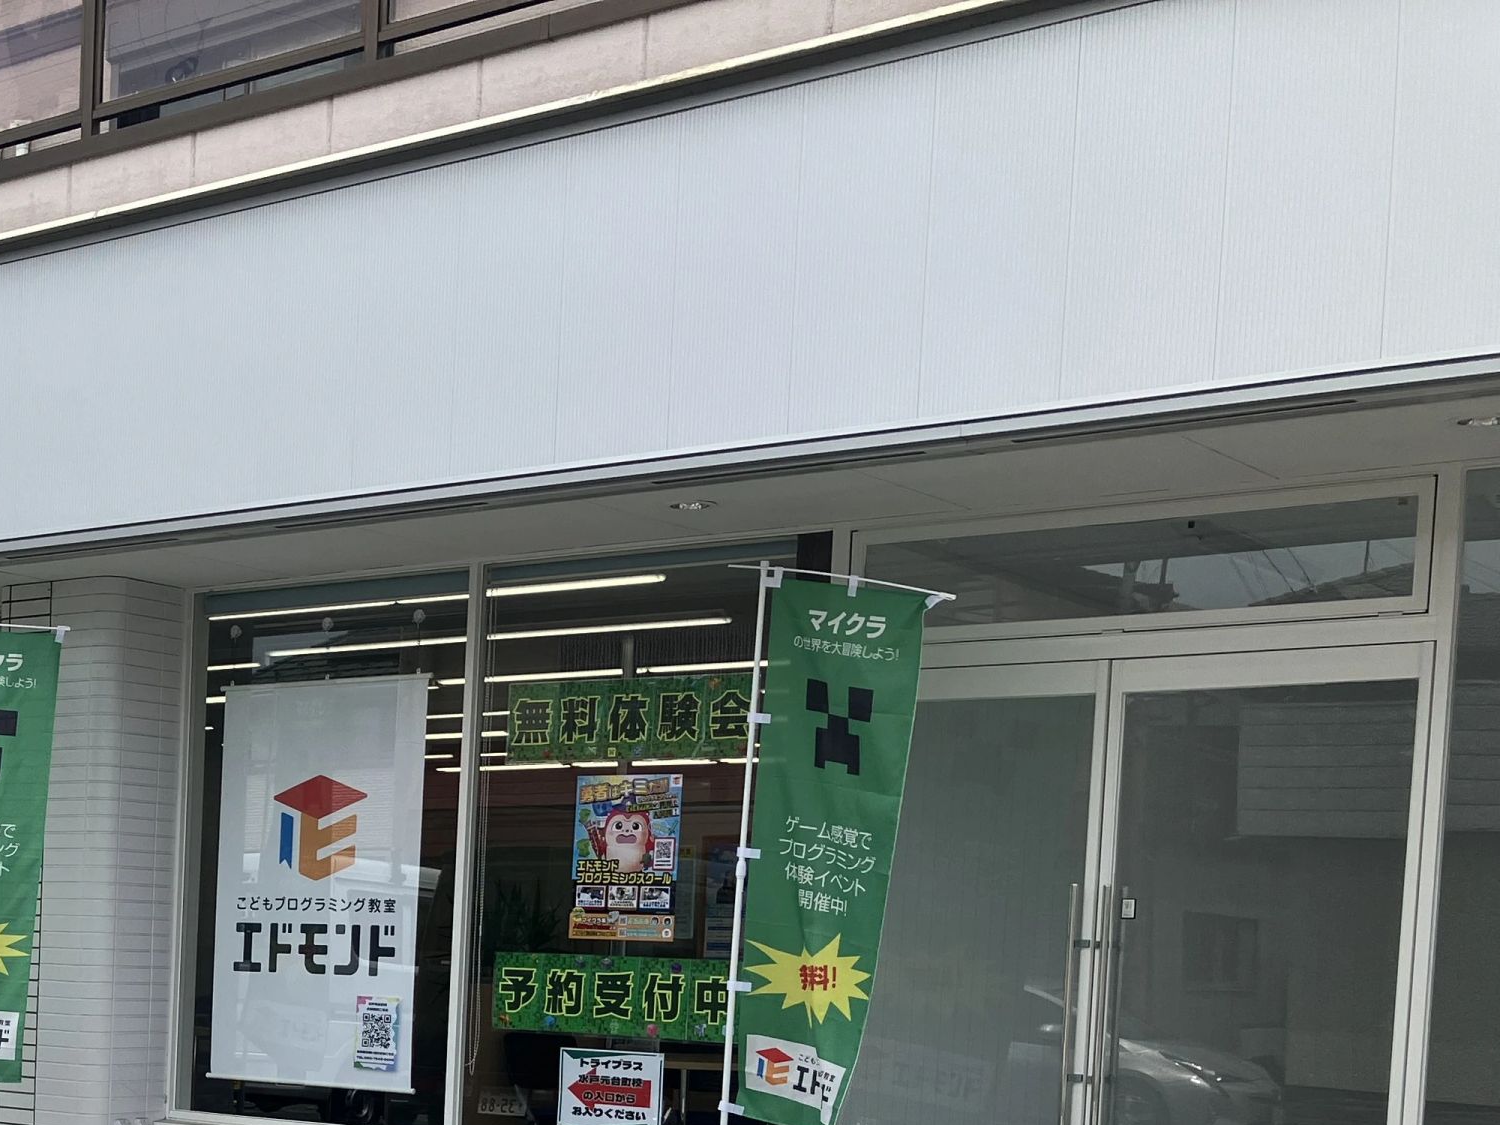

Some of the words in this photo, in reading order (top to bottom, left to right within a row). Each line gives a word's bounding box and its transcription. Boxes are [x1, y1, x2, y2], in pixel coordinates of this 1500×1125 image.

[808, 608, 887, 639] マイクラ
[793, 635, 900, 662] の世界を大冒険しよう!
[512, 690, 751, 744] 無料体験会
[784, 815, 873, 849] ゲーム感覚で
[778, 837, 876, 874] プログラミング
[784, 861, 867, 896] 体験イベント
[236, 897, 396, 913] こどもプログラミング教室
[798, 888, 848, 917] 開催中!
[233, 922, 396, 977] エドモンド
[500, 968, 729, 1025] 予約受付中
[579, 1058, 643, 1071] トライプラス
[578, 1074, 643, 1088] 水戸元台町校
[583, 1092, 636, 1103] の入口から
[572, 1106, 647, 1121] お入りください
